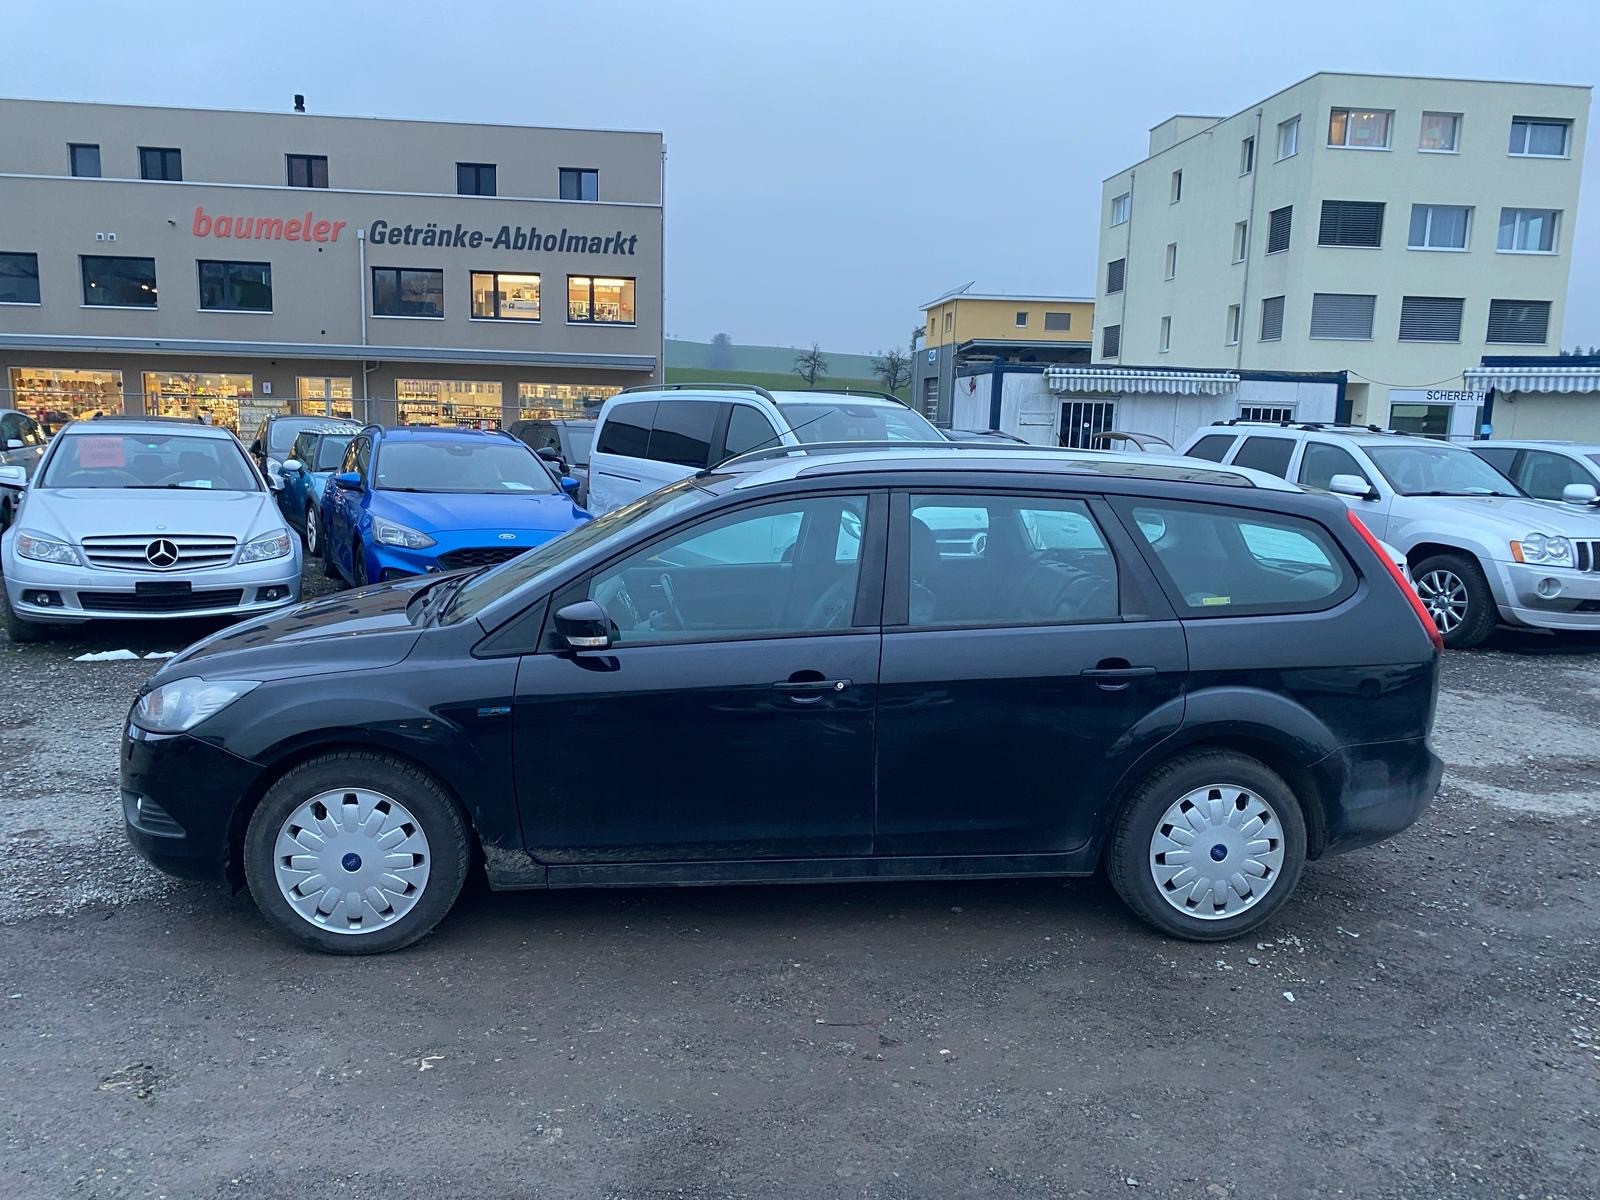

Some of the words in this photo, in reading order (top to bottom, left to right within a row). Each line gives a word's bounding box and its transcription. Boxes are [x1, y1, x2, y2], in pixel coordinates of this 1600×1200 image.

[192, 206, 346, 243] baumeler
[369, 219, 638, 256] Getränke-Abholmarkt
[1426, 390, 1474, 401] SCHERER
